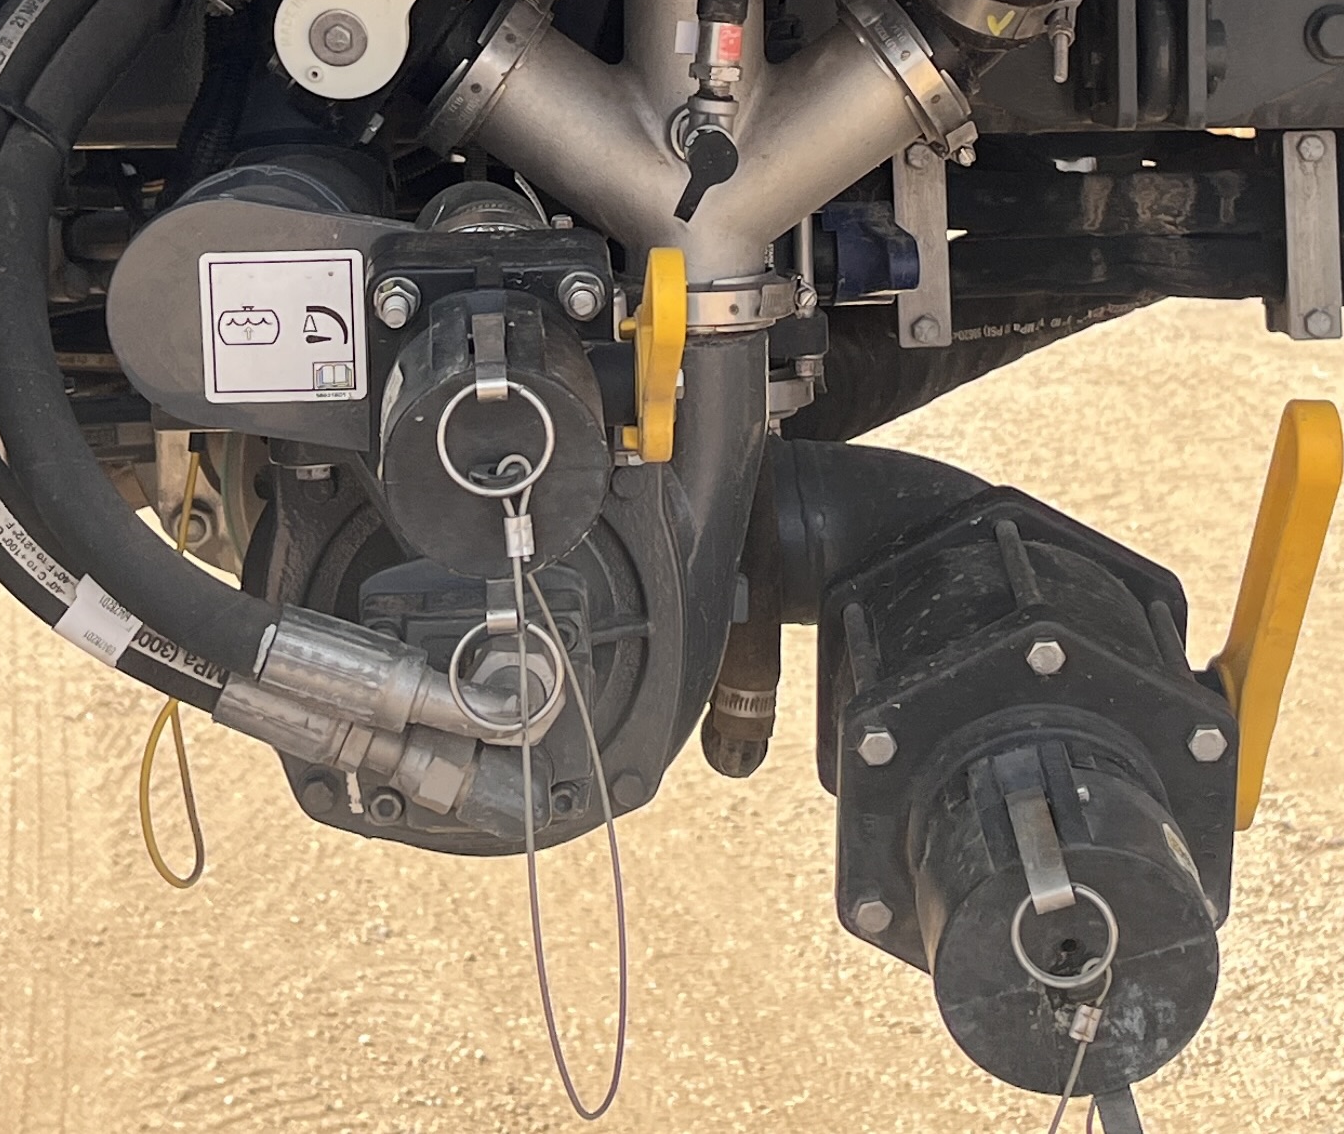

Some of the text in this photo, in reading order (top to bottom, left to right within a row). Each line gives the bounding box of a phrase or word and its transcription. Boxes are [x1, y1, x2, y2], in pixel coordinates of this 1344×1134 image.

[4, 520, 14, 530] F
[46, 563, 55, 572] F
[35, 570, 48, 582] C
[182, 650, 230, 684] MPa
